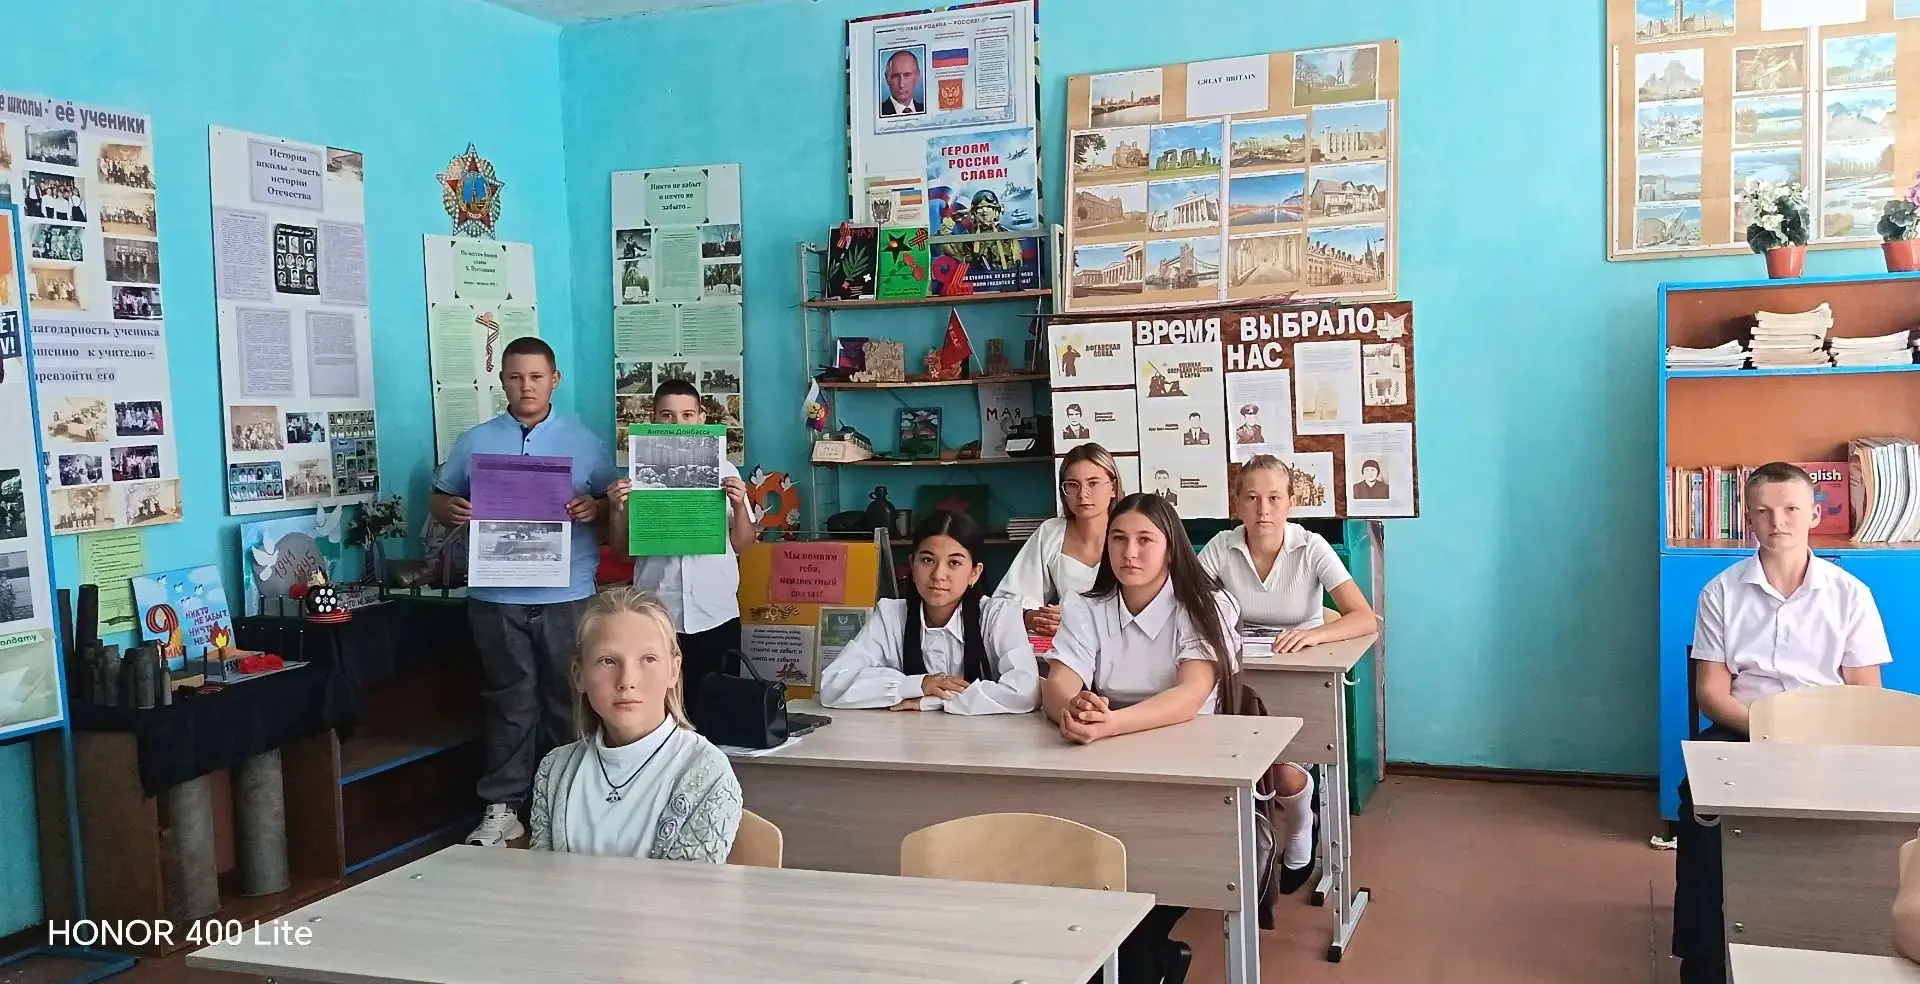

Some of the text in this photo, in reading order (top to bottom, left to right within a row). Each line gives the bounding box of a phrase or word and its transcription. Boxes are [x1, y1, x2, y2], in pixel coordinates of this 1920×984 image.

[1197, 73, 1256, 86] GREAT BRITAIN
[8, 96, 42, 118] школы
[55, 101, 75, 123] её
[80, 108, 145, 134] ученики
[269, 148, 307, 162] История
[941, 142, 990, 156] ГЕРОЯМ
[256, 160, 288, 172] школы
[297, 168, 321, 177] часть
[948, 156, 999, 169] РОССИИ
[960, 167, 1009, 182] СЛАВА!
[271, 176, 308, 188] истории
[267, 186, 312, 201] Отечества
[32, 323, 160, 338] лагодарность ученика
[1240, 307, 1375, 342] ВЫБРАЛО
[88, 349, 95, 358] к
[98, 349, 146, 360] учителю
[1227, 342, 1284, 370] НАС
[97, 373, 115, 383] его
[986, 407, 1021, 421] МАЯ
[647, 428, 710, 436] Ангелы Донбасса
[1809, 468, 1842, 484] glish
[783, 550, 800, 560] Мы
[779, 577, 837, 587] неизвестный
[185, 606, 209, 619] НИКТО
[194, 617, 205, 625] НЕ
[0, 634, 37, 646] олдату
